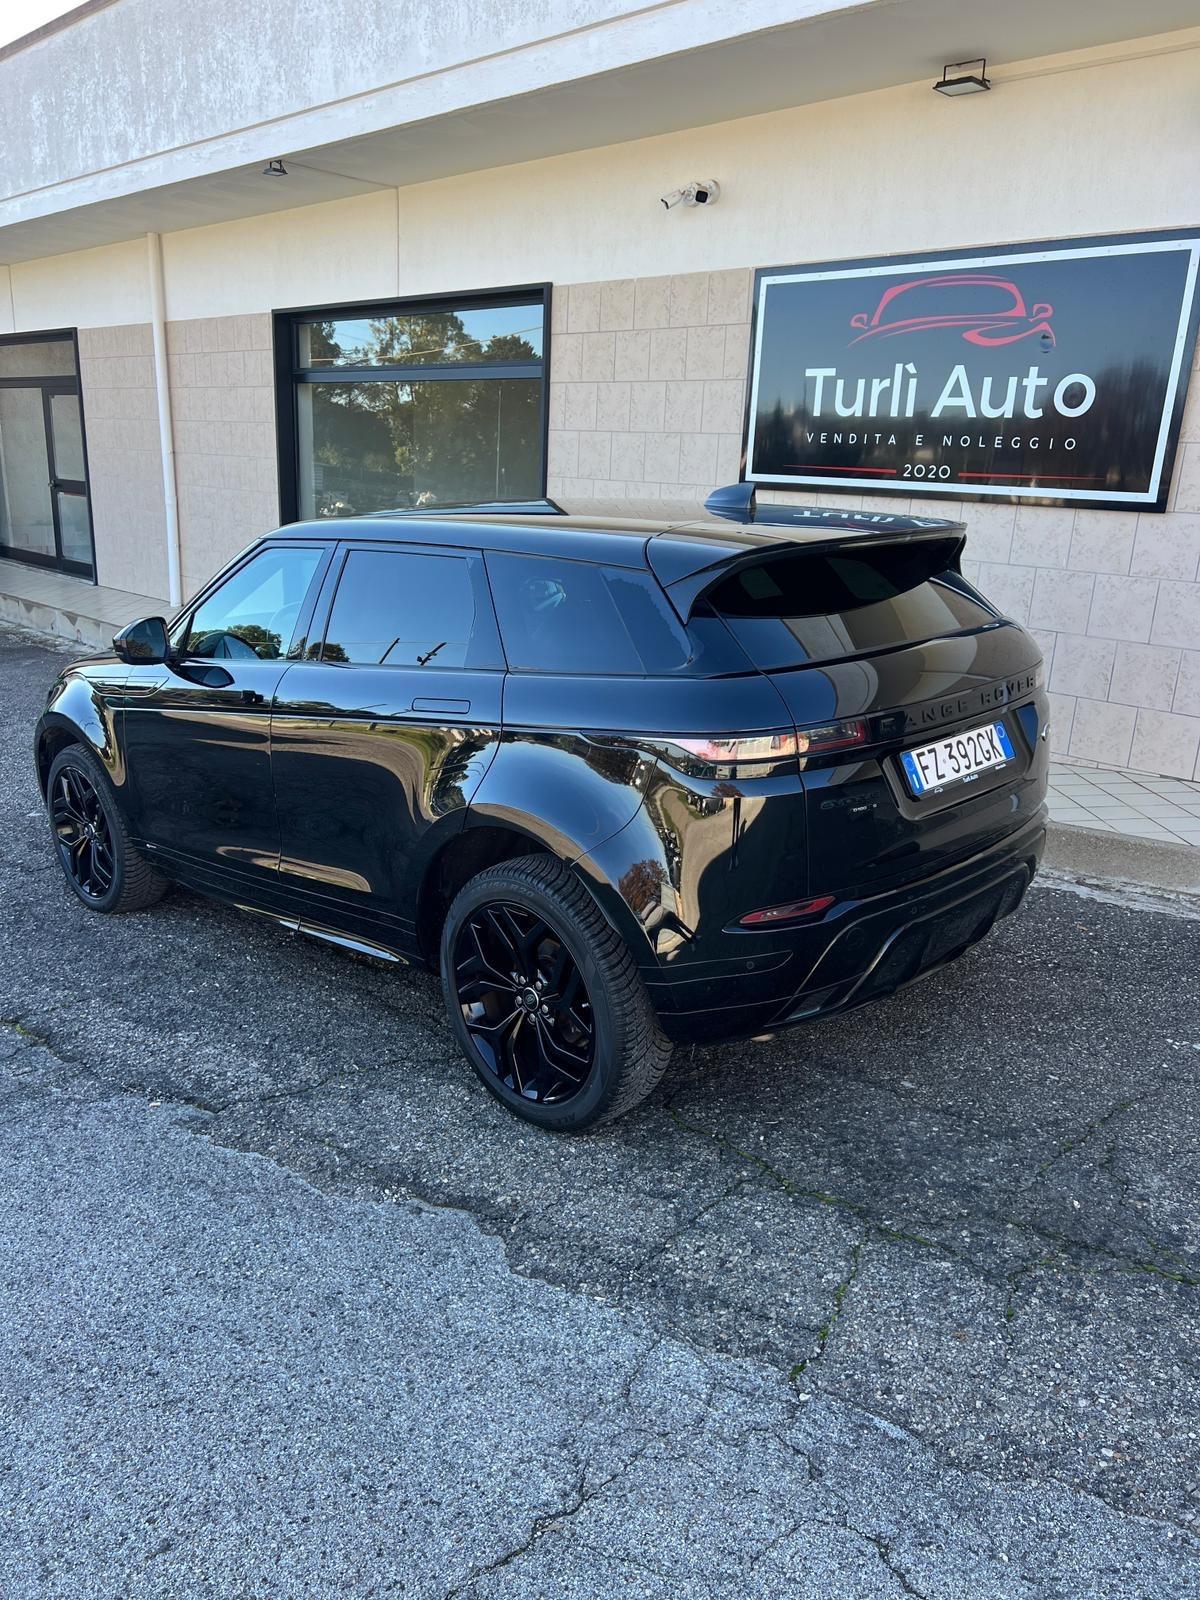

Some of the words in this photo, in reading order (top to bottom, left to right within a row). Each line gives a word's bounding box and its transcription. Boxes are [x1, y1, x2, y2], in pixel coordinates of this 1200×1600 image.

[805, 363, 918, 417] Turlì
[931, 364, 1096, 419] Auto
[806, 433, 897, 445] VENDITA
[915, 434, 924, 446] E
[943, 435, 1077, 450] NOLEGGIO
[903, 463, 951, 479] 2020
[880, 700, 968, 733] RANGE
[981, 677, 1034, 705] ROVER
[916, 748, 946, 785] FZ
[944, 728, 1003, 774] 392GK
